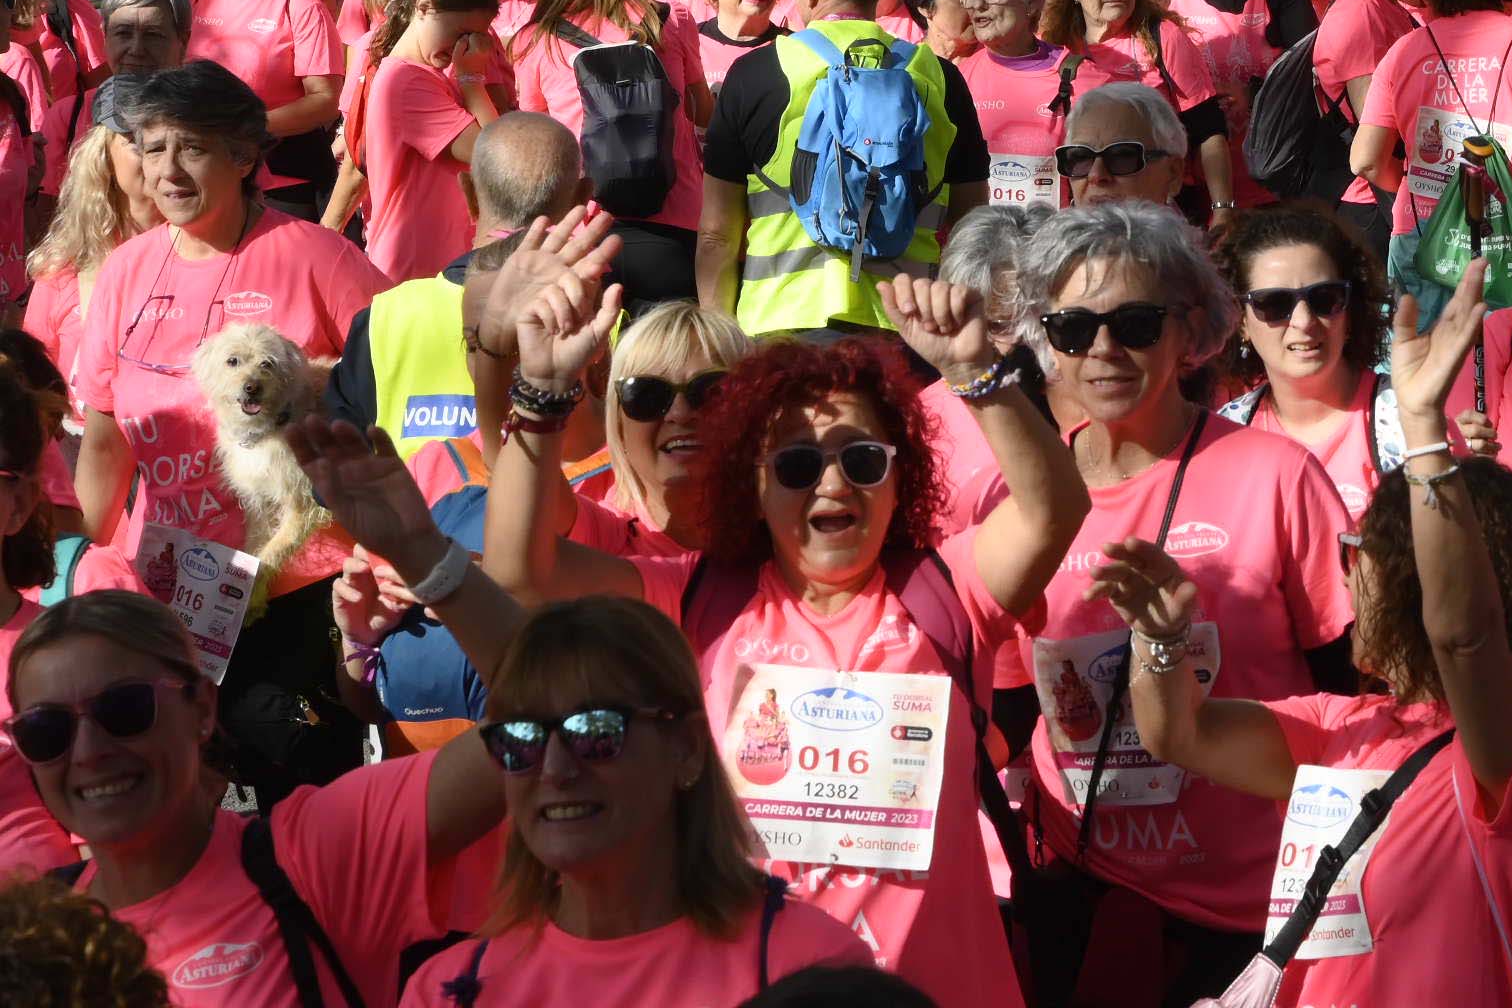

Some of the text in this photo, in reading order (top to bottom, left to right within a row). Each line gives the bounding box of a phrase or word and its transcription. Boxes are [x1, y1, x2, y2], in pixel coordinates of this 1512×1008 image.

[1422, 56, 1501, 75] CARRERA
[1464, 73, 1485, 88] LA
[1434, 88, 1489, 106] MUJER
[991, 167, 1028, 178] ASTURIANA
[993, 187, 1026, 202] 016
[404, 405, 477, 428] VOLUN
[121, 414, 158, 446] TU
[175, 583, 205, 611] 016
[799, 699, 876, 722] ASTURIANA
[893, 701, 933, 713] SUMA
[797, 745, 870, 774] 016
[1119, 754, 1134, 765] DE
[803, 781, 859, 800] 12382
[1073, 778, 1120, 793] OYHO
[745, 803, 918, 824] CARRERA DE LA MUJER 2023
[1092, 810, 1199, 851] UMA
[756, 829, 921, 853] YSHO Santander
[1281, 842, 1315, 868] 01
